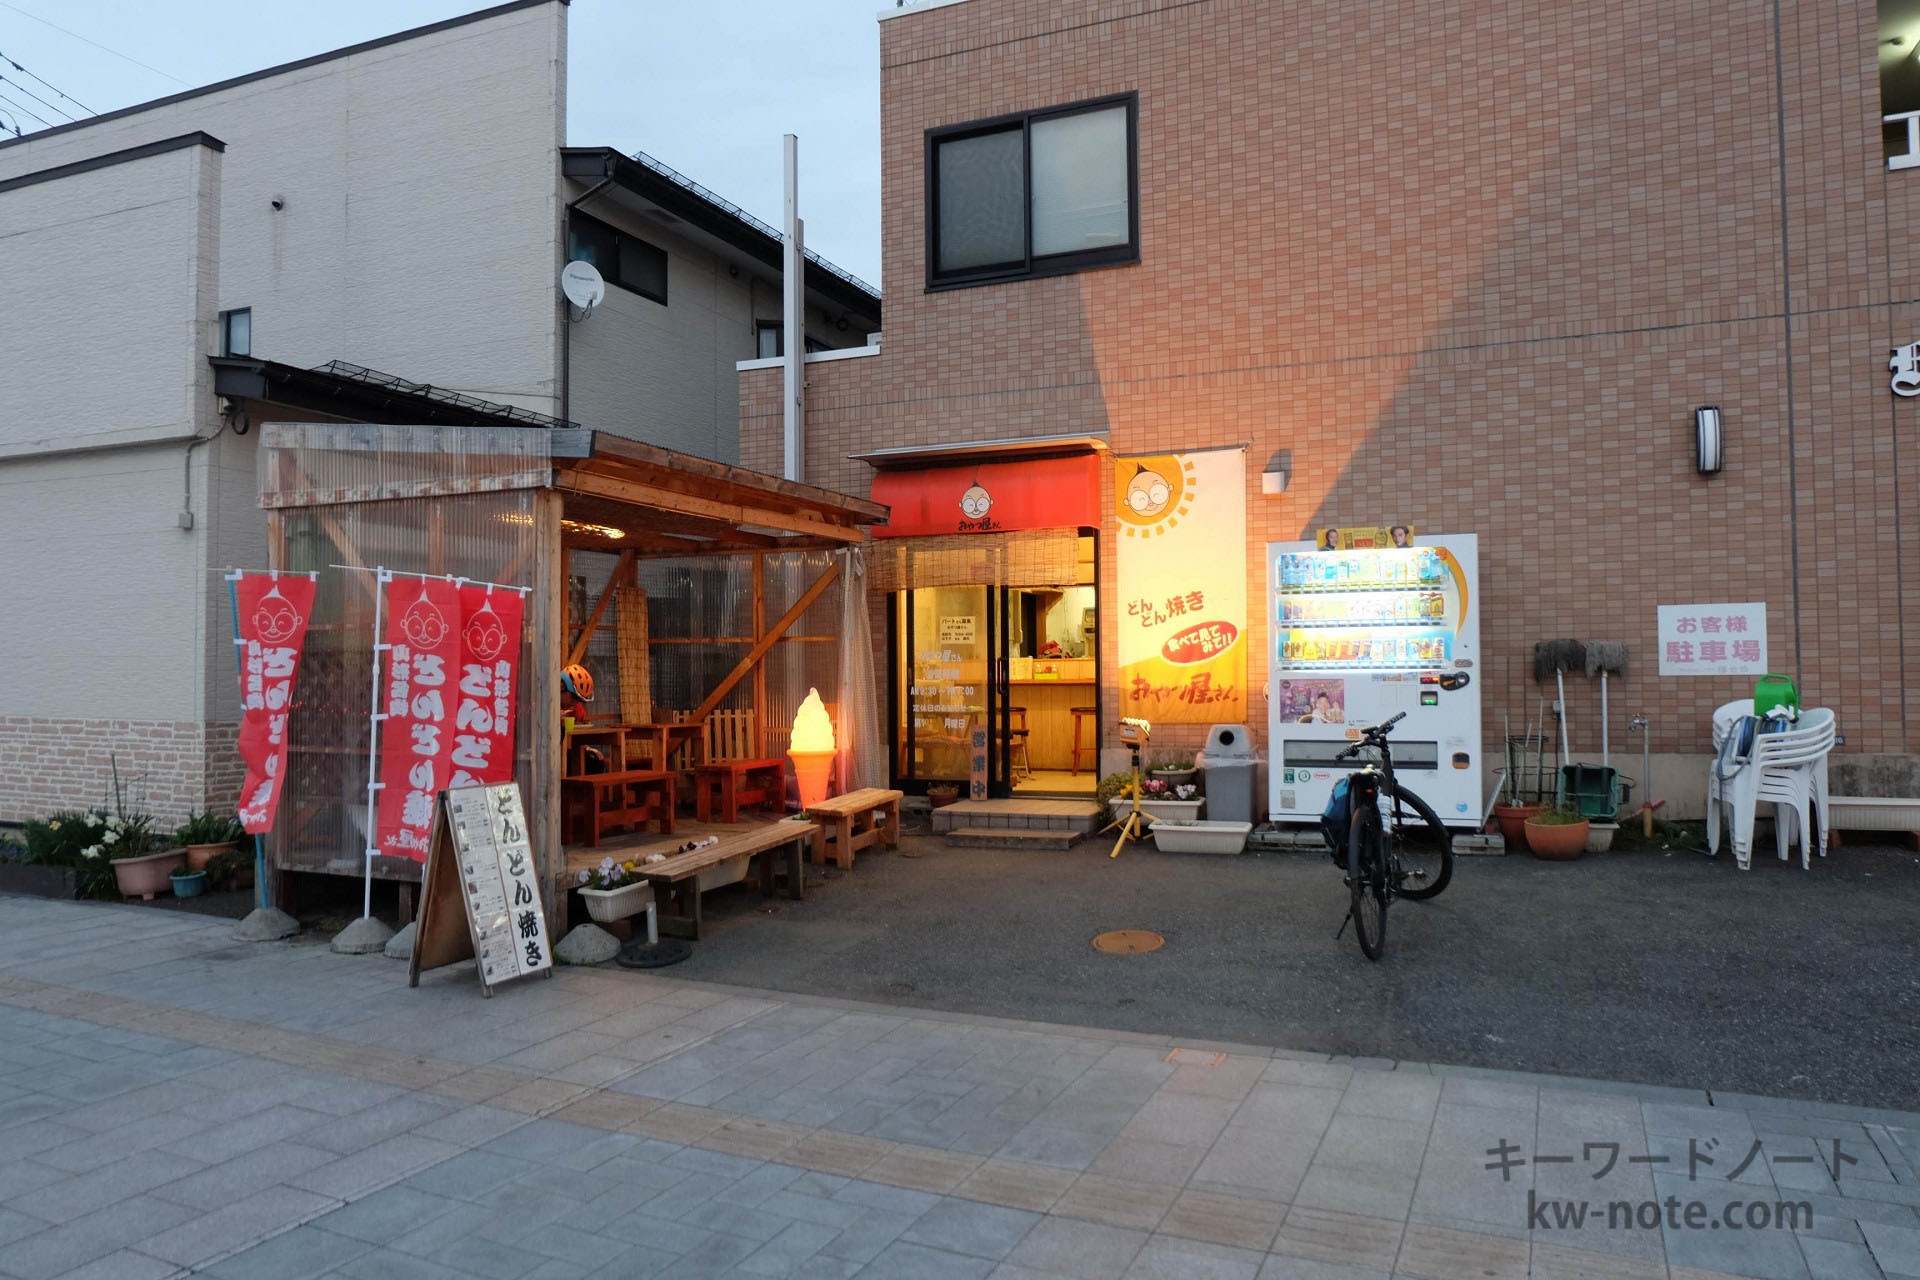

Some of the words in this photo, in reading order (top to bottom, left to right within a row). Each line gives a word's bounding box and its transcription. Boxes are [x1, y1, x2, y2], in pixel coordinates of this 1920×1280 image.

[1676, 616, 1748, 633] お客様
[1666, 640, 1760, 663] 駐車場
[498, 787, 542, 966] どんどん焼き
